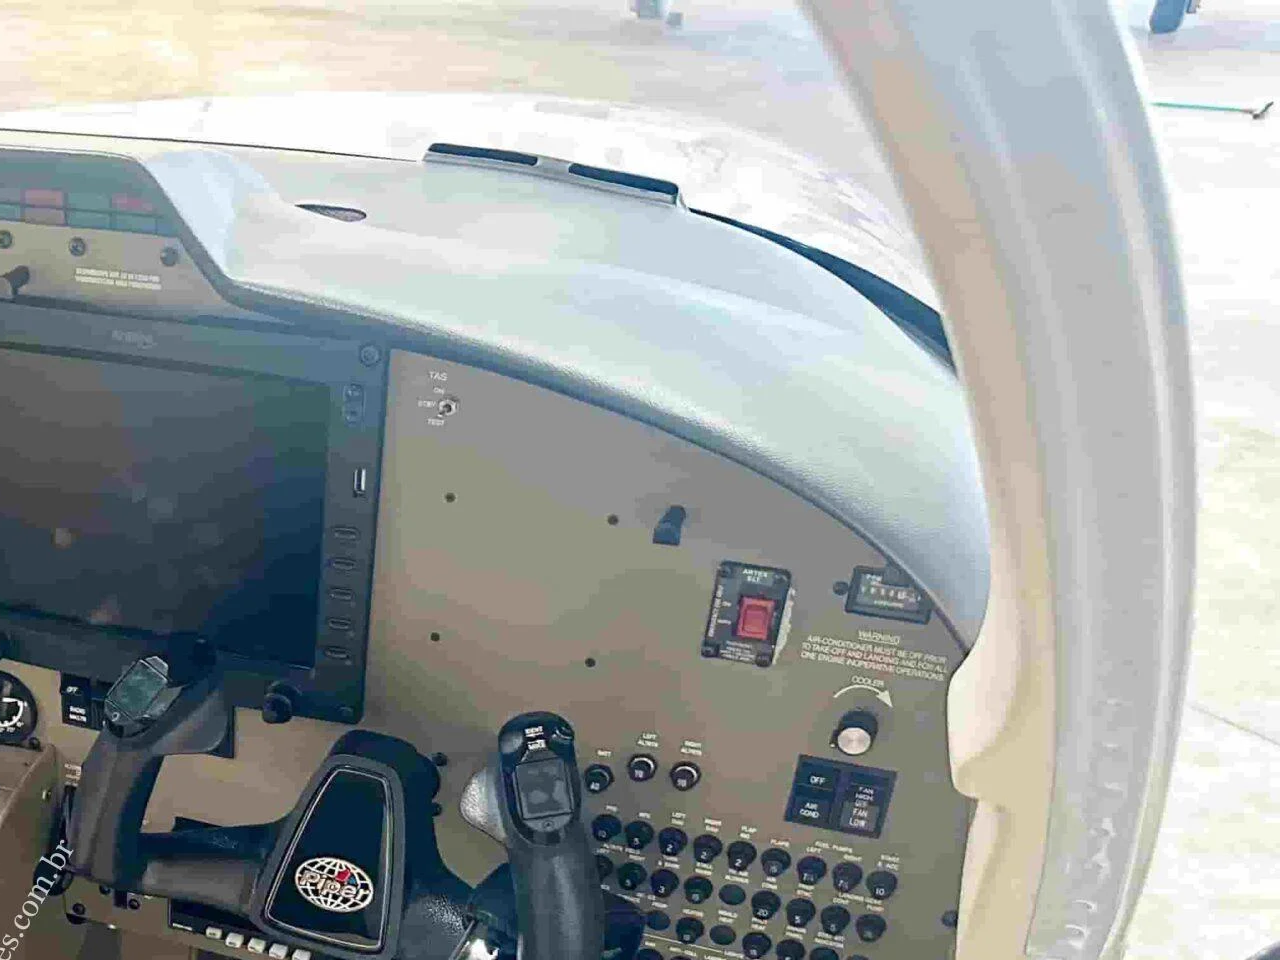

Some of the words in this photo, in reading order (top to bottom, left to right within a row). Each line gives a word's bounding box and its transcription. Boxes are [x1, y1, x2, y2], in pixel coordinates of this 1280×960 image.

[429, 371, 448, 381] TAS
[858, 630, 901, 645] WARNING
[801, 641, 811, 650] TO
[846, 649, 863, 659] AND
[863, 651, 899, 665] LANDING
[873, 644, 897, 656] MUST
[800, 652, 816, 661] ONE
[851, 675, 886, 688] COOLER
[809, 775, 826, 785] OFF
[858, 786, 875, 795] FAN
[800, 809, 820, 819] COND
[852, 808, 868, 818] FAN
[849, 817, 867, 828] LOW
[666, 844, 673, 852] 2
[701, 852, 708, 860] 2
[735, 859, 742, 867] 2
[299, 869, 371, 901] Piper
[658, 885, 665, 894] 3
[875, 888, 885, 896] 10
[757, 908, 769, 917] 20
